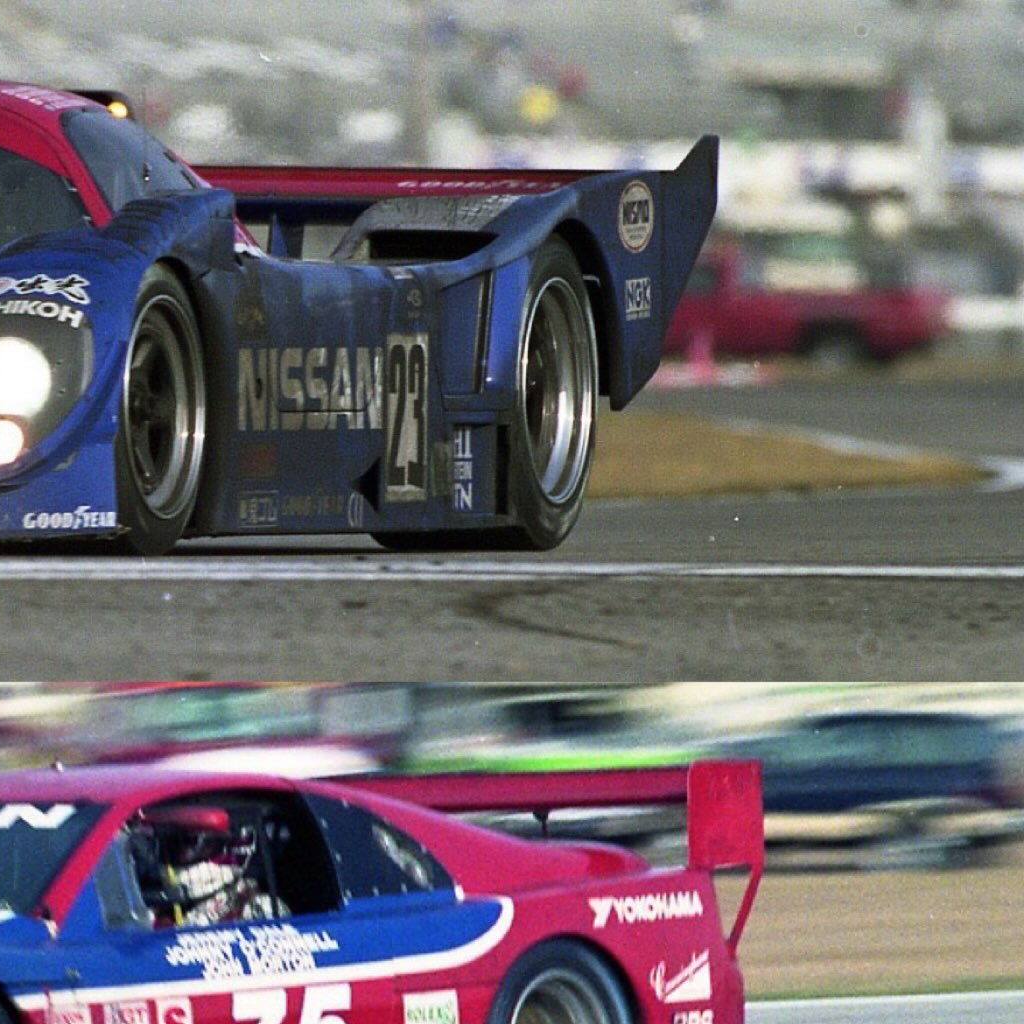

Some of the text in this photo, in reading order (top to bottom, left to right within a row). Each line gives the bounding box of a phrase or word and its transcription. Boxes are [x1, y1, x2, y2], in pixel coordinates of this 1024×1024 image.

[626, 278, 652, 310] NGK
[238, 347, 383, 431] NISSAN
[389, 344, 425, 486] 23
[613, 890, 703, 923] YOKOHAMA
